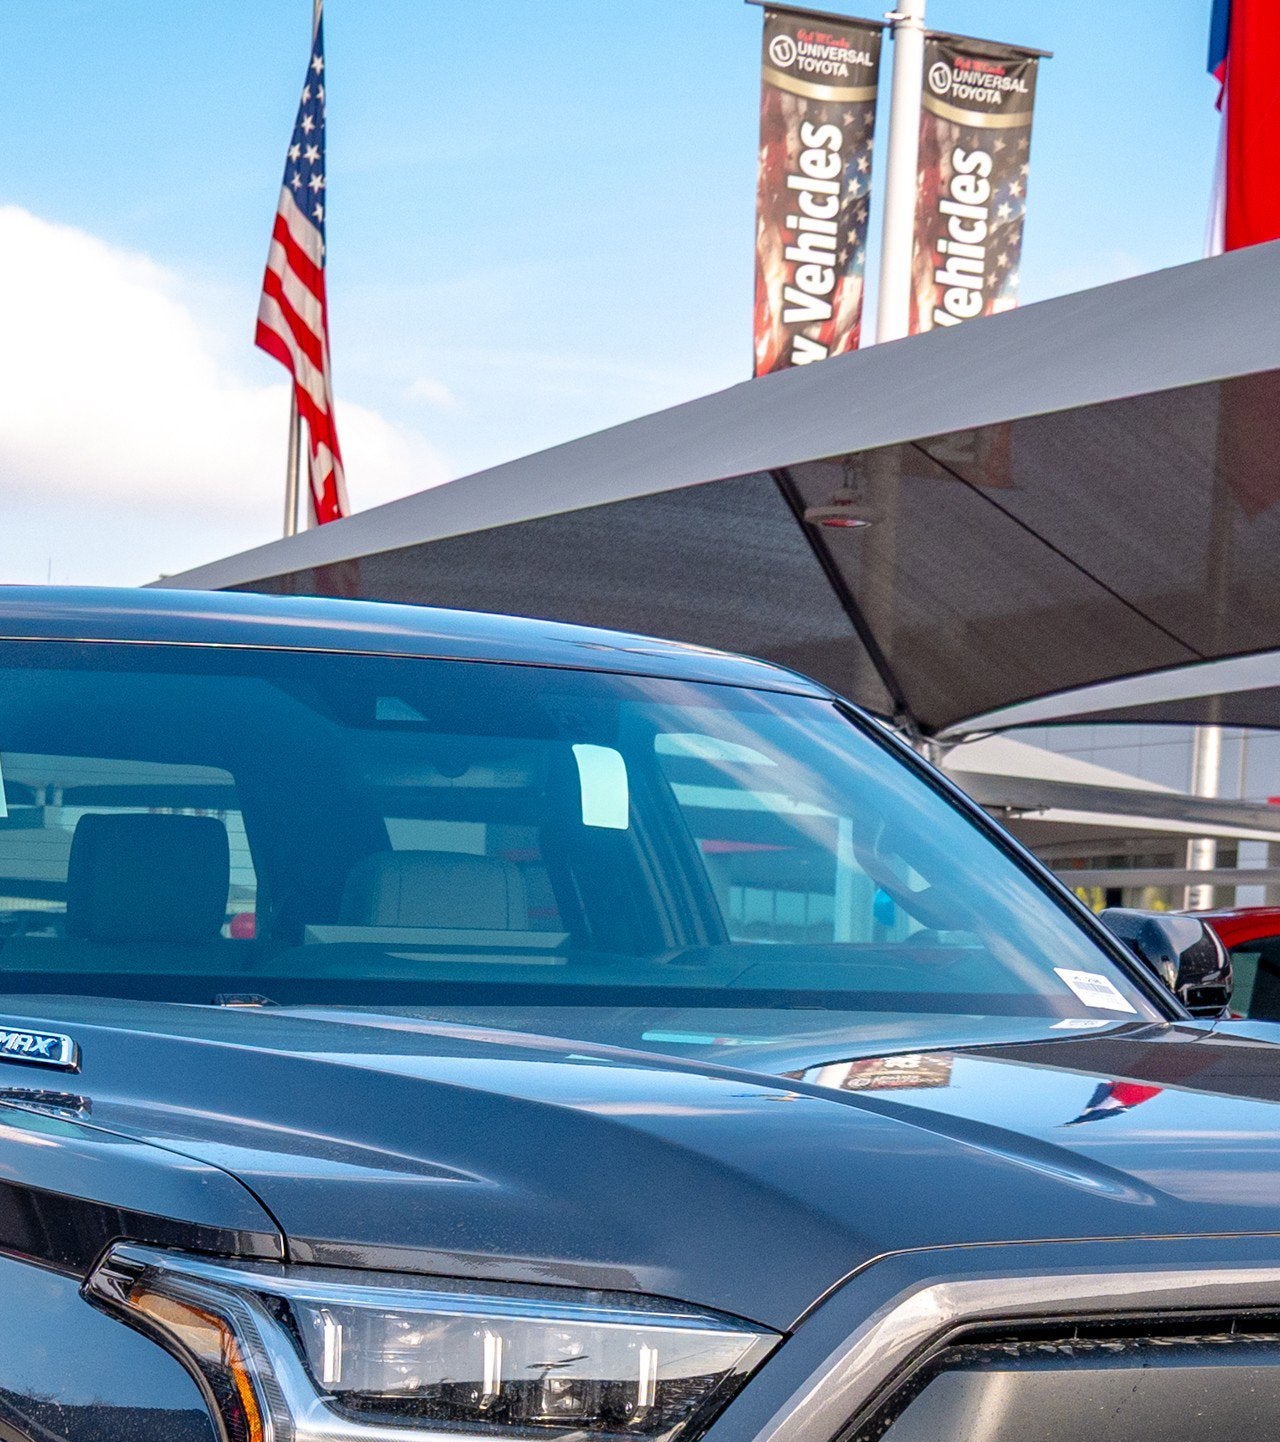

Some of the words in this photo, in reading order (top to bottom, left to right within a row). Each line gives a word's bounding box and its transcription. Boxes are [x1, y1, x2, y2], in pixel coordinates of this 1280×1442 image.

[797, 41, 874, 67] UNIVERSAL
[797, 55, 849, 77] TOYOTA
[952, 69, 1029, 93] UNIVERSAL
[952, 83, 1002, 105] TOYOTA
[783, 121, 843, 323] Vehicles
